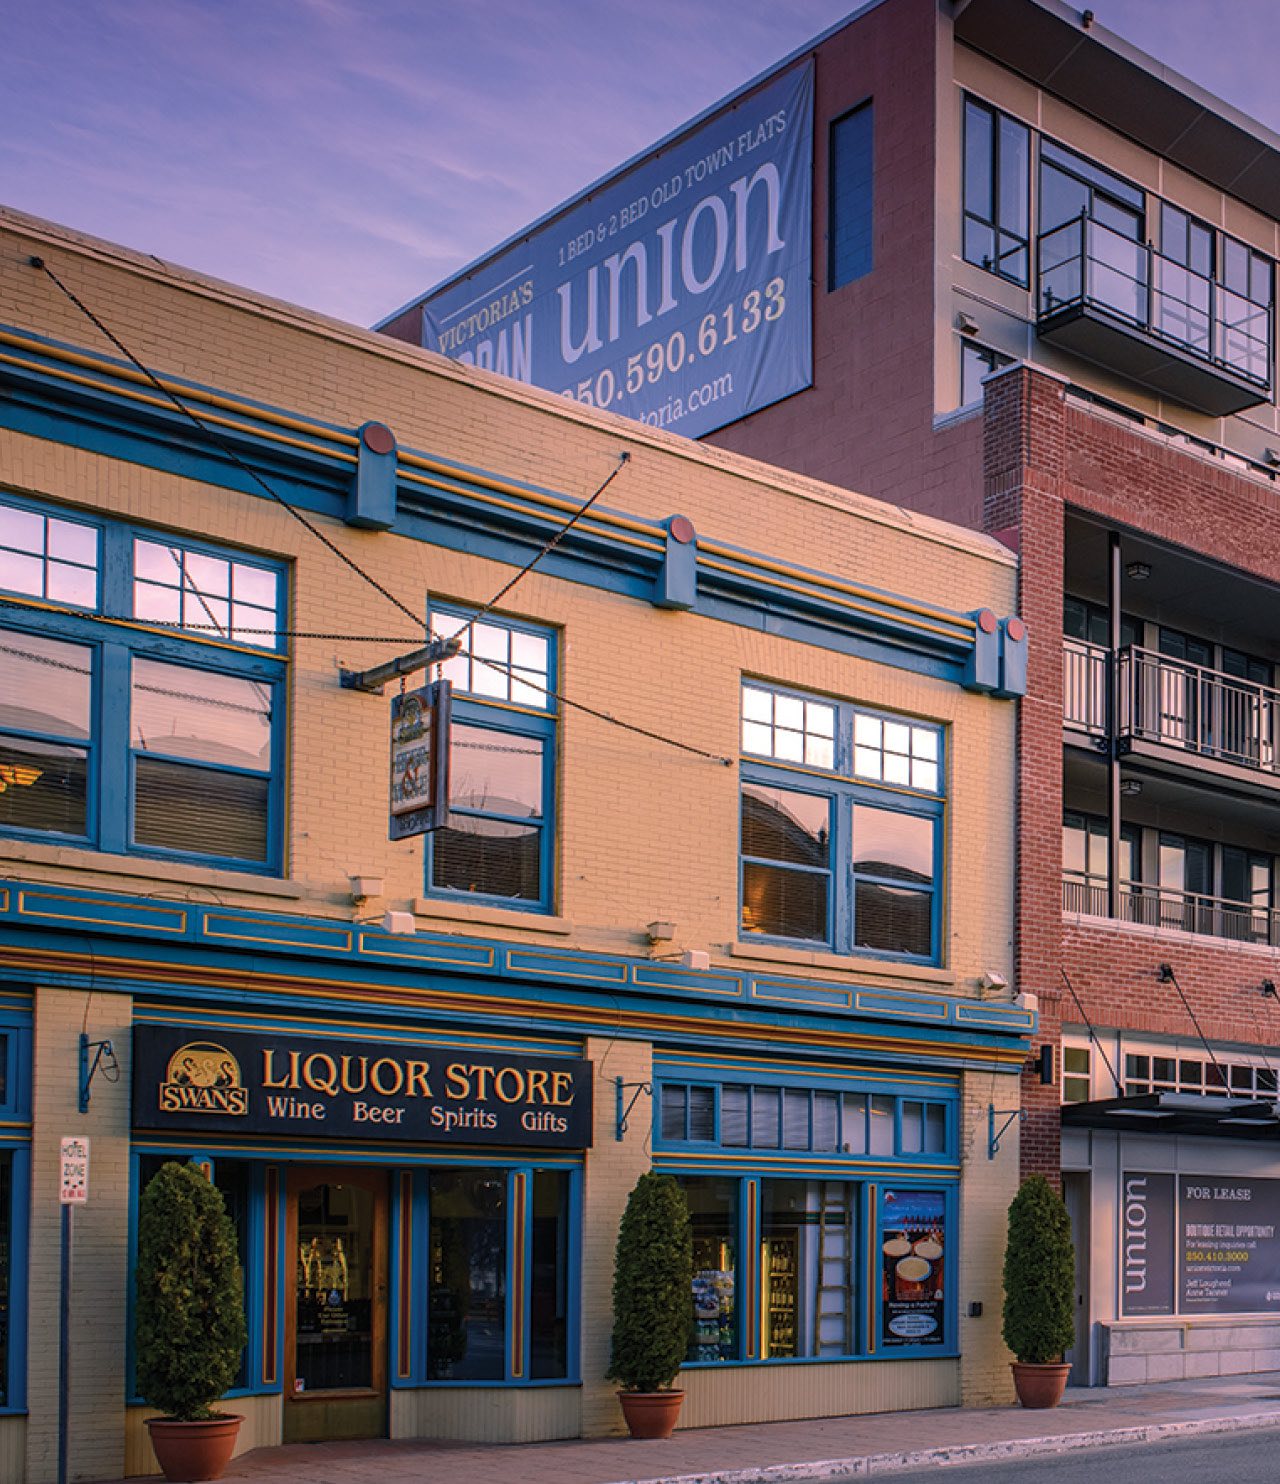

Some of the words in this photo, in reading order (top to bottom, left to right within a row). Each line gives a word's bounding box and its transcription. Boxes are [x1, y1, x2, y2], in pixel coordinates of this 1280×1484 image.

[557, 246, 567, 268] 1
[567, 228, 594, 262] BED
[596, 221, 607, 243] &
[608, 213, 619, 237] 2
[619, 196, 650, 230] BED
[651, 174, 684, 210] OLD
[684, 140, 735, 190] TOWN
[737, 109, 788, 157] FLATS
[556, 161, 786, 364] union
[437, 279, 535, 354] VICTORIA'S
[164, 1085, 244, 1115] SWANS
[261, 1048, 434, 1097] LIQUOR
[445, 1062, 575, 1106] STORE
[266, 1096, 326, 1120] Wine
[352, 1101, 406, 1125] Beer
[429, 1105, 498, 1132] Spirits
[520, 1110, 568, 1133] Gifts
[1186, 1186, 1211, 1200] FOR
[1213, 1187, 1252, 1201] LEASE
[1126, 1177, 1147, 1293] union
